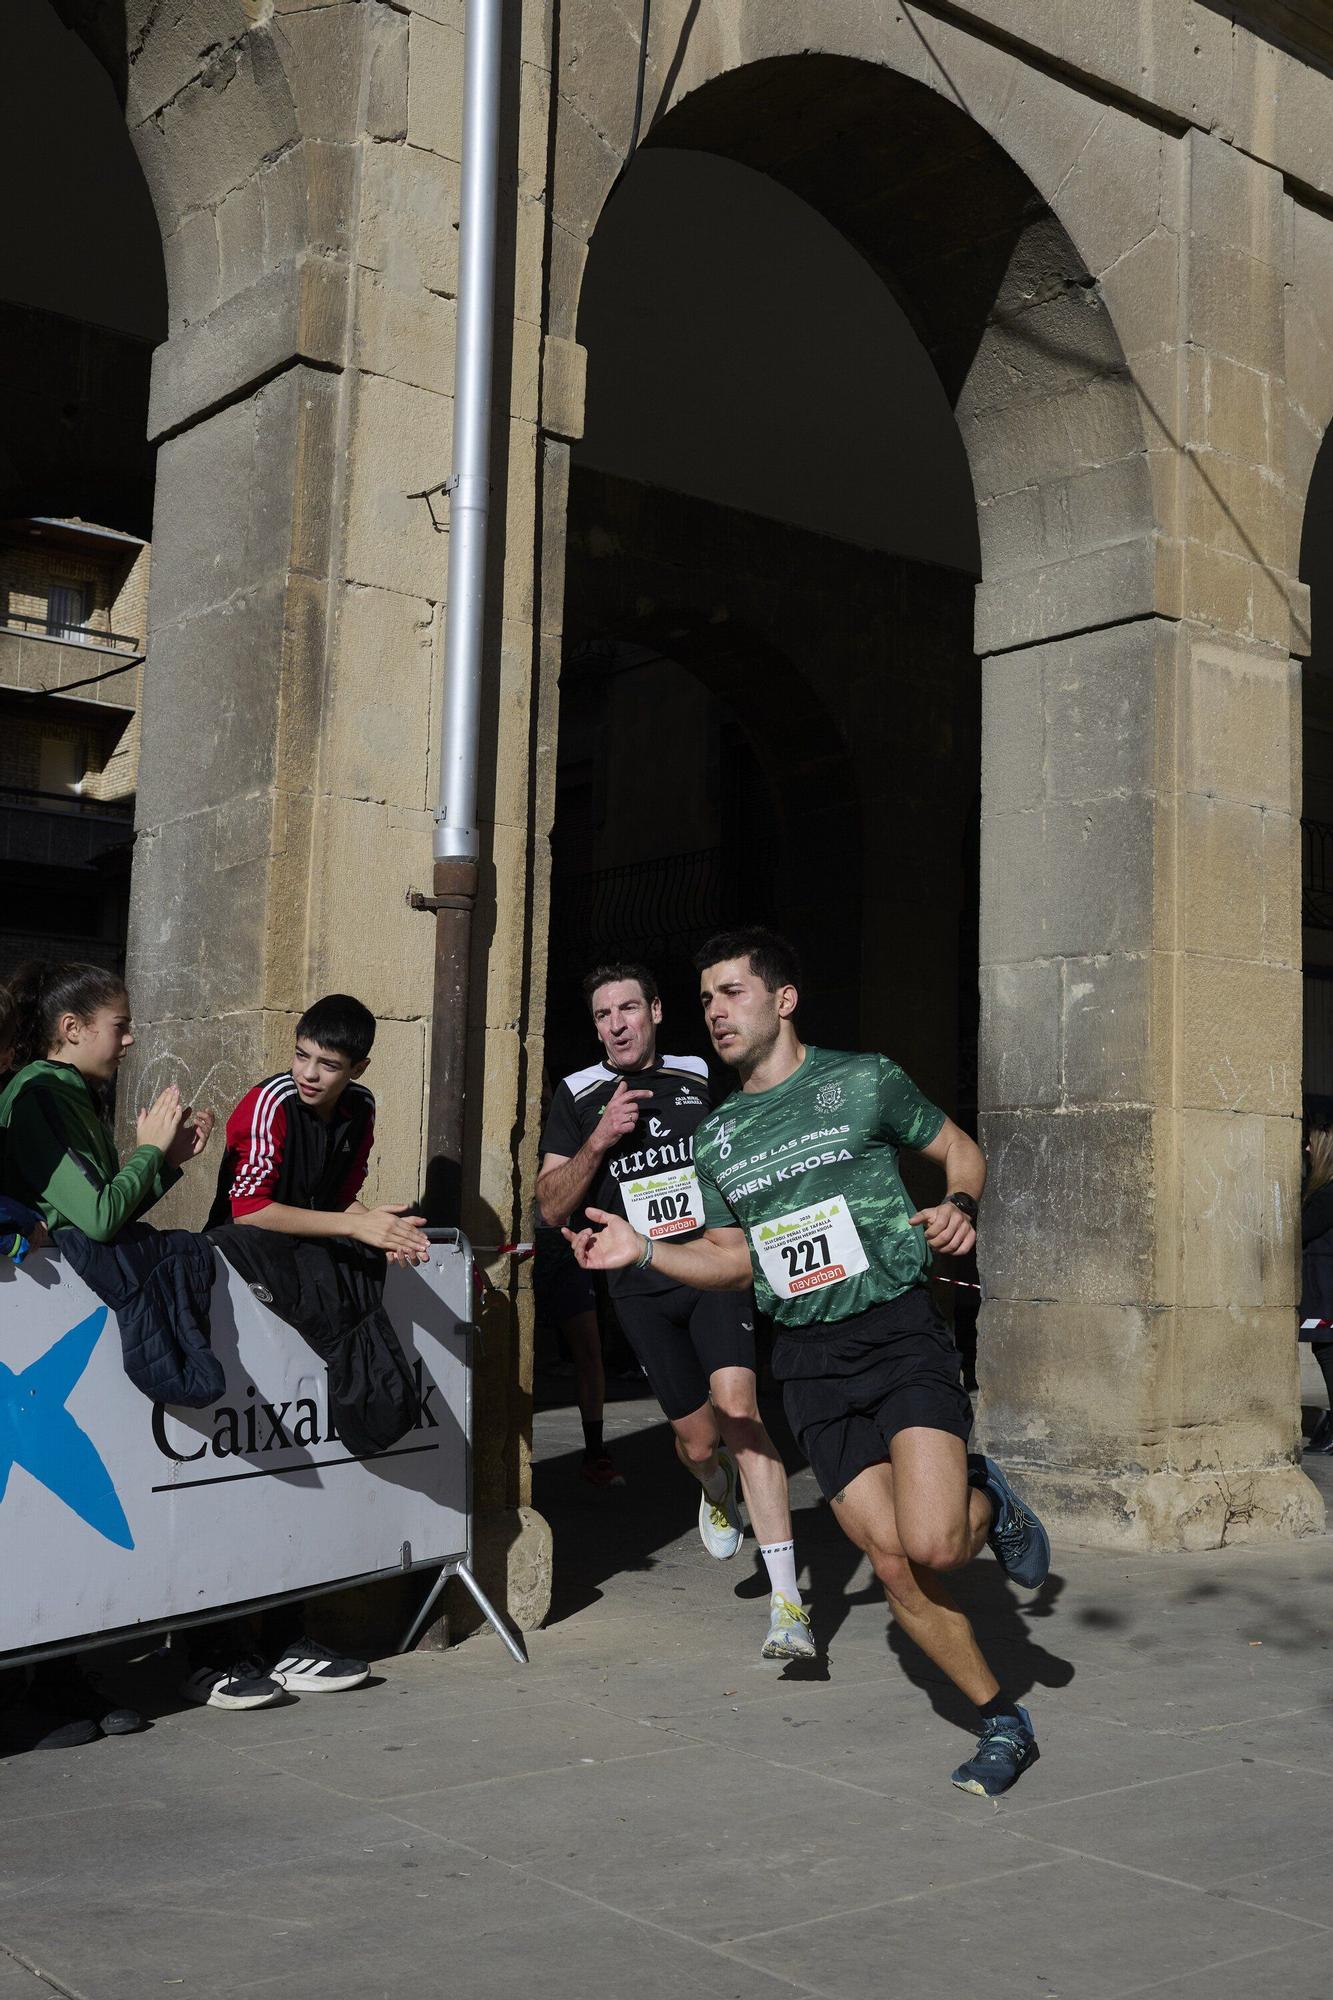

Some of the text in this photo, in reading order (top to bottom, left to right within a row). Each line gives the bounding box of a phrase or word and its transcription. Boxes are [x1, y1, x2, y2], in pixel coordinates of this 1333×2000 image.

[716, 1124, 850, 1184] CROSS DE LAS PEÑAS
[776, 1148, 855, 1182] KROSA
[648, 1192, 692, 1223] 402
[652, 1219, 695, 1236] navarban
[781, 1233, 831, 1277] 227
[791, 1267, 843, 1291] navarban
